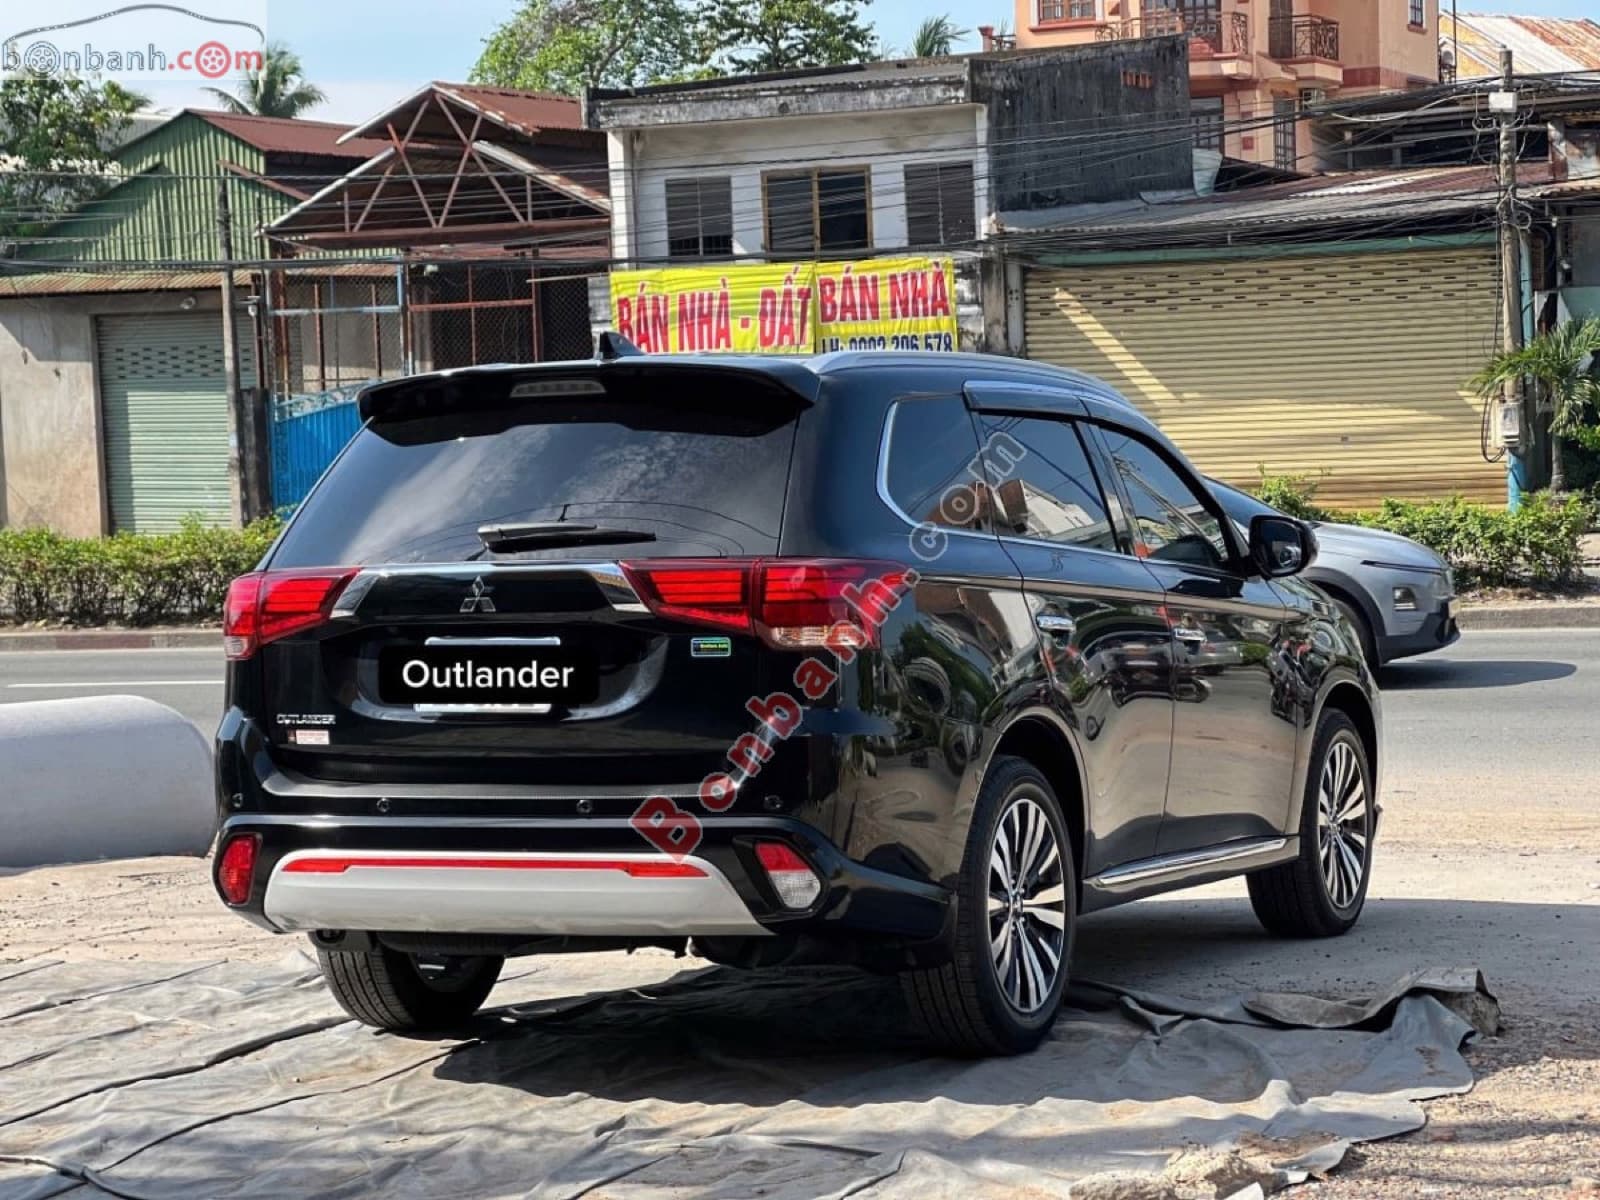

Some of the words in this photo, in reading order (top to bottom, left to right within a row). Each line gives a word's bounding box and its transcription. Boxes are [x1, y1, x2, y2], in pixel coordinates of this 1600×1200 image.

[617, 282, 669, 352] BÁN
[678, 277, 731, 351] NHÀ
[759, 265, 812, 347] ĐẤT
[818, 266, 880, 323] BÁN
[889, 261, 950, 319] NHÀ
[924, 332, 952, 352] 578
[276, 714, 336, 724] OUTLANDER
